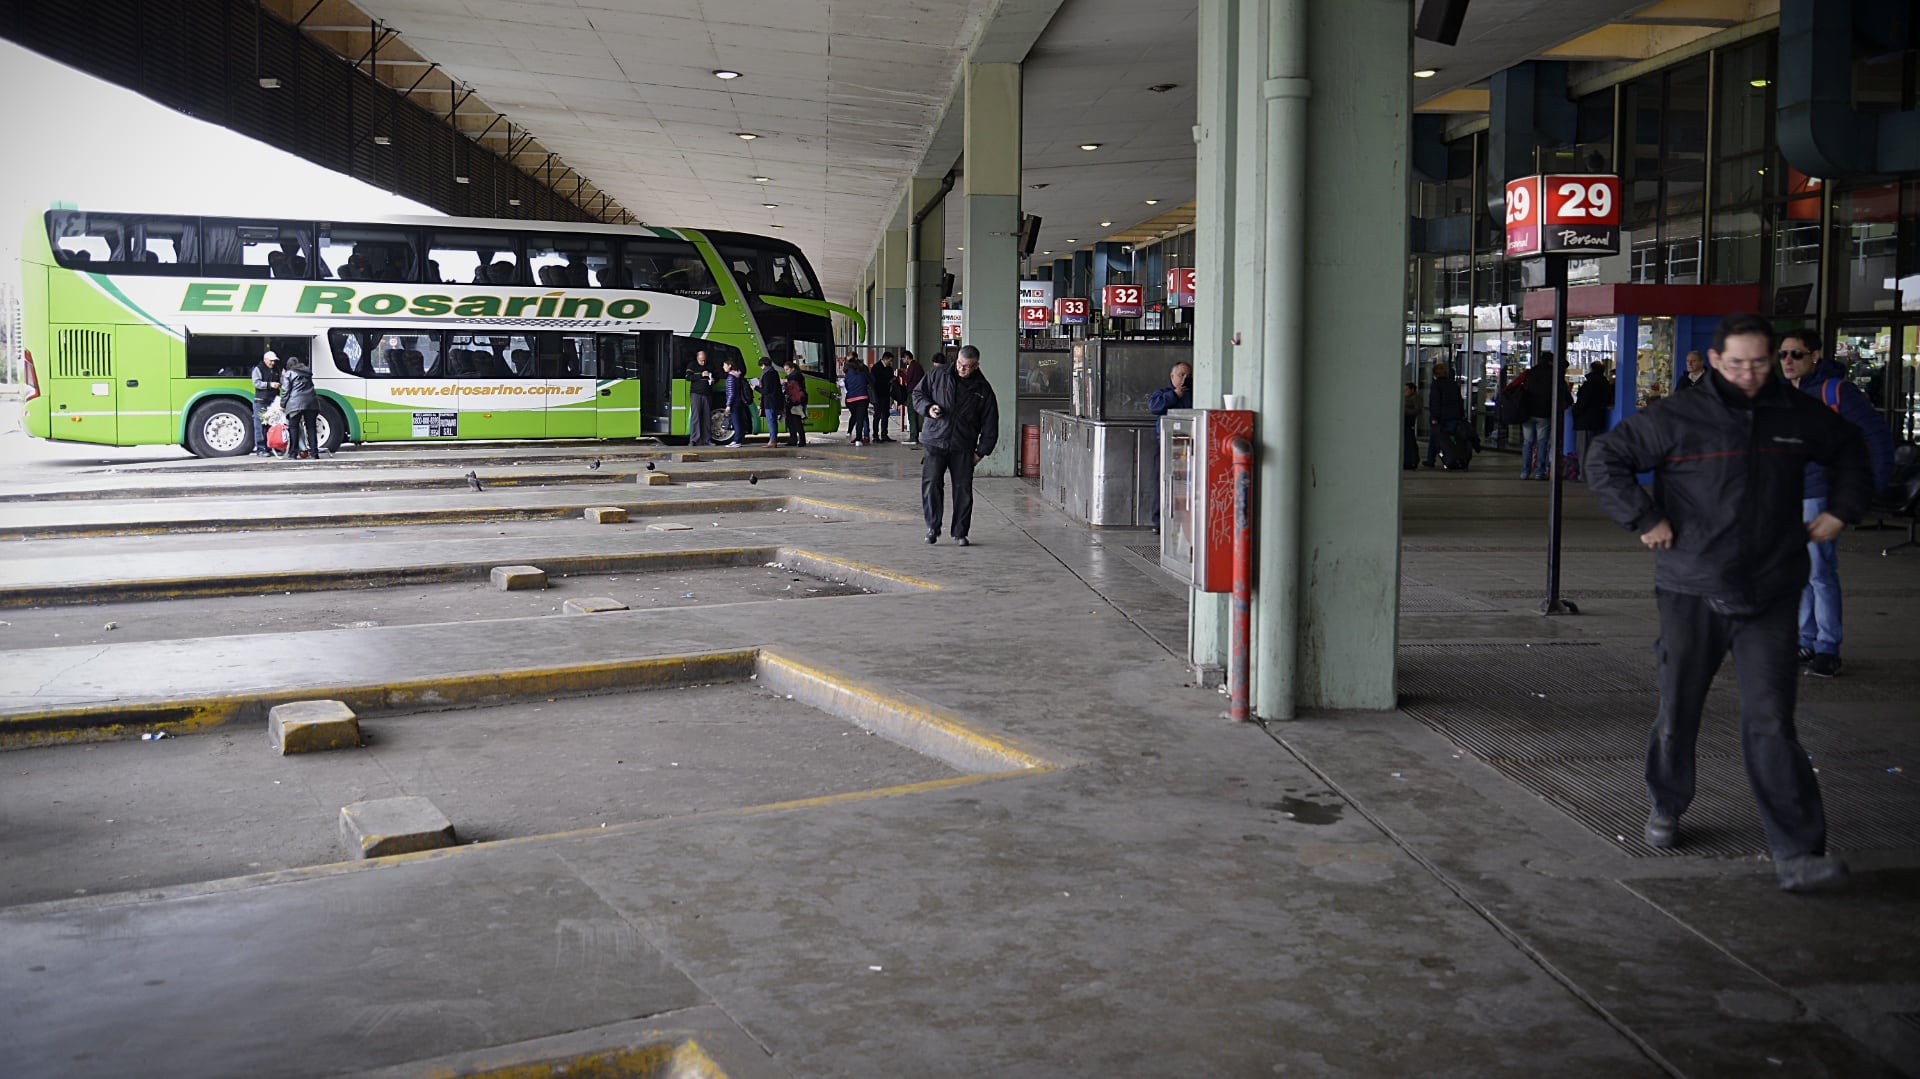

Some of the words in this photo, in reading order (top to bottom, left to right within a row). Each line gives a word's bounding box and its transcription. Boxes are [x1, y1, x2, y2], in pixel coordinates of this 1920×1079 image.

[1506, 186, 1530, 224] 29
[1557, 183, 1611, 217] 29
[1557, 229, 1610, 246] Personal
[1186, 272, 1196, 290] 3
[180, 282, 268, 312] El
[1114, 288, 1138, 303] 32
[1027, 308, 1044, 320] 34
[1065, 301, 1084, 314] 33
[390, 384, 583, 396] www.elrosarino.com.ar
